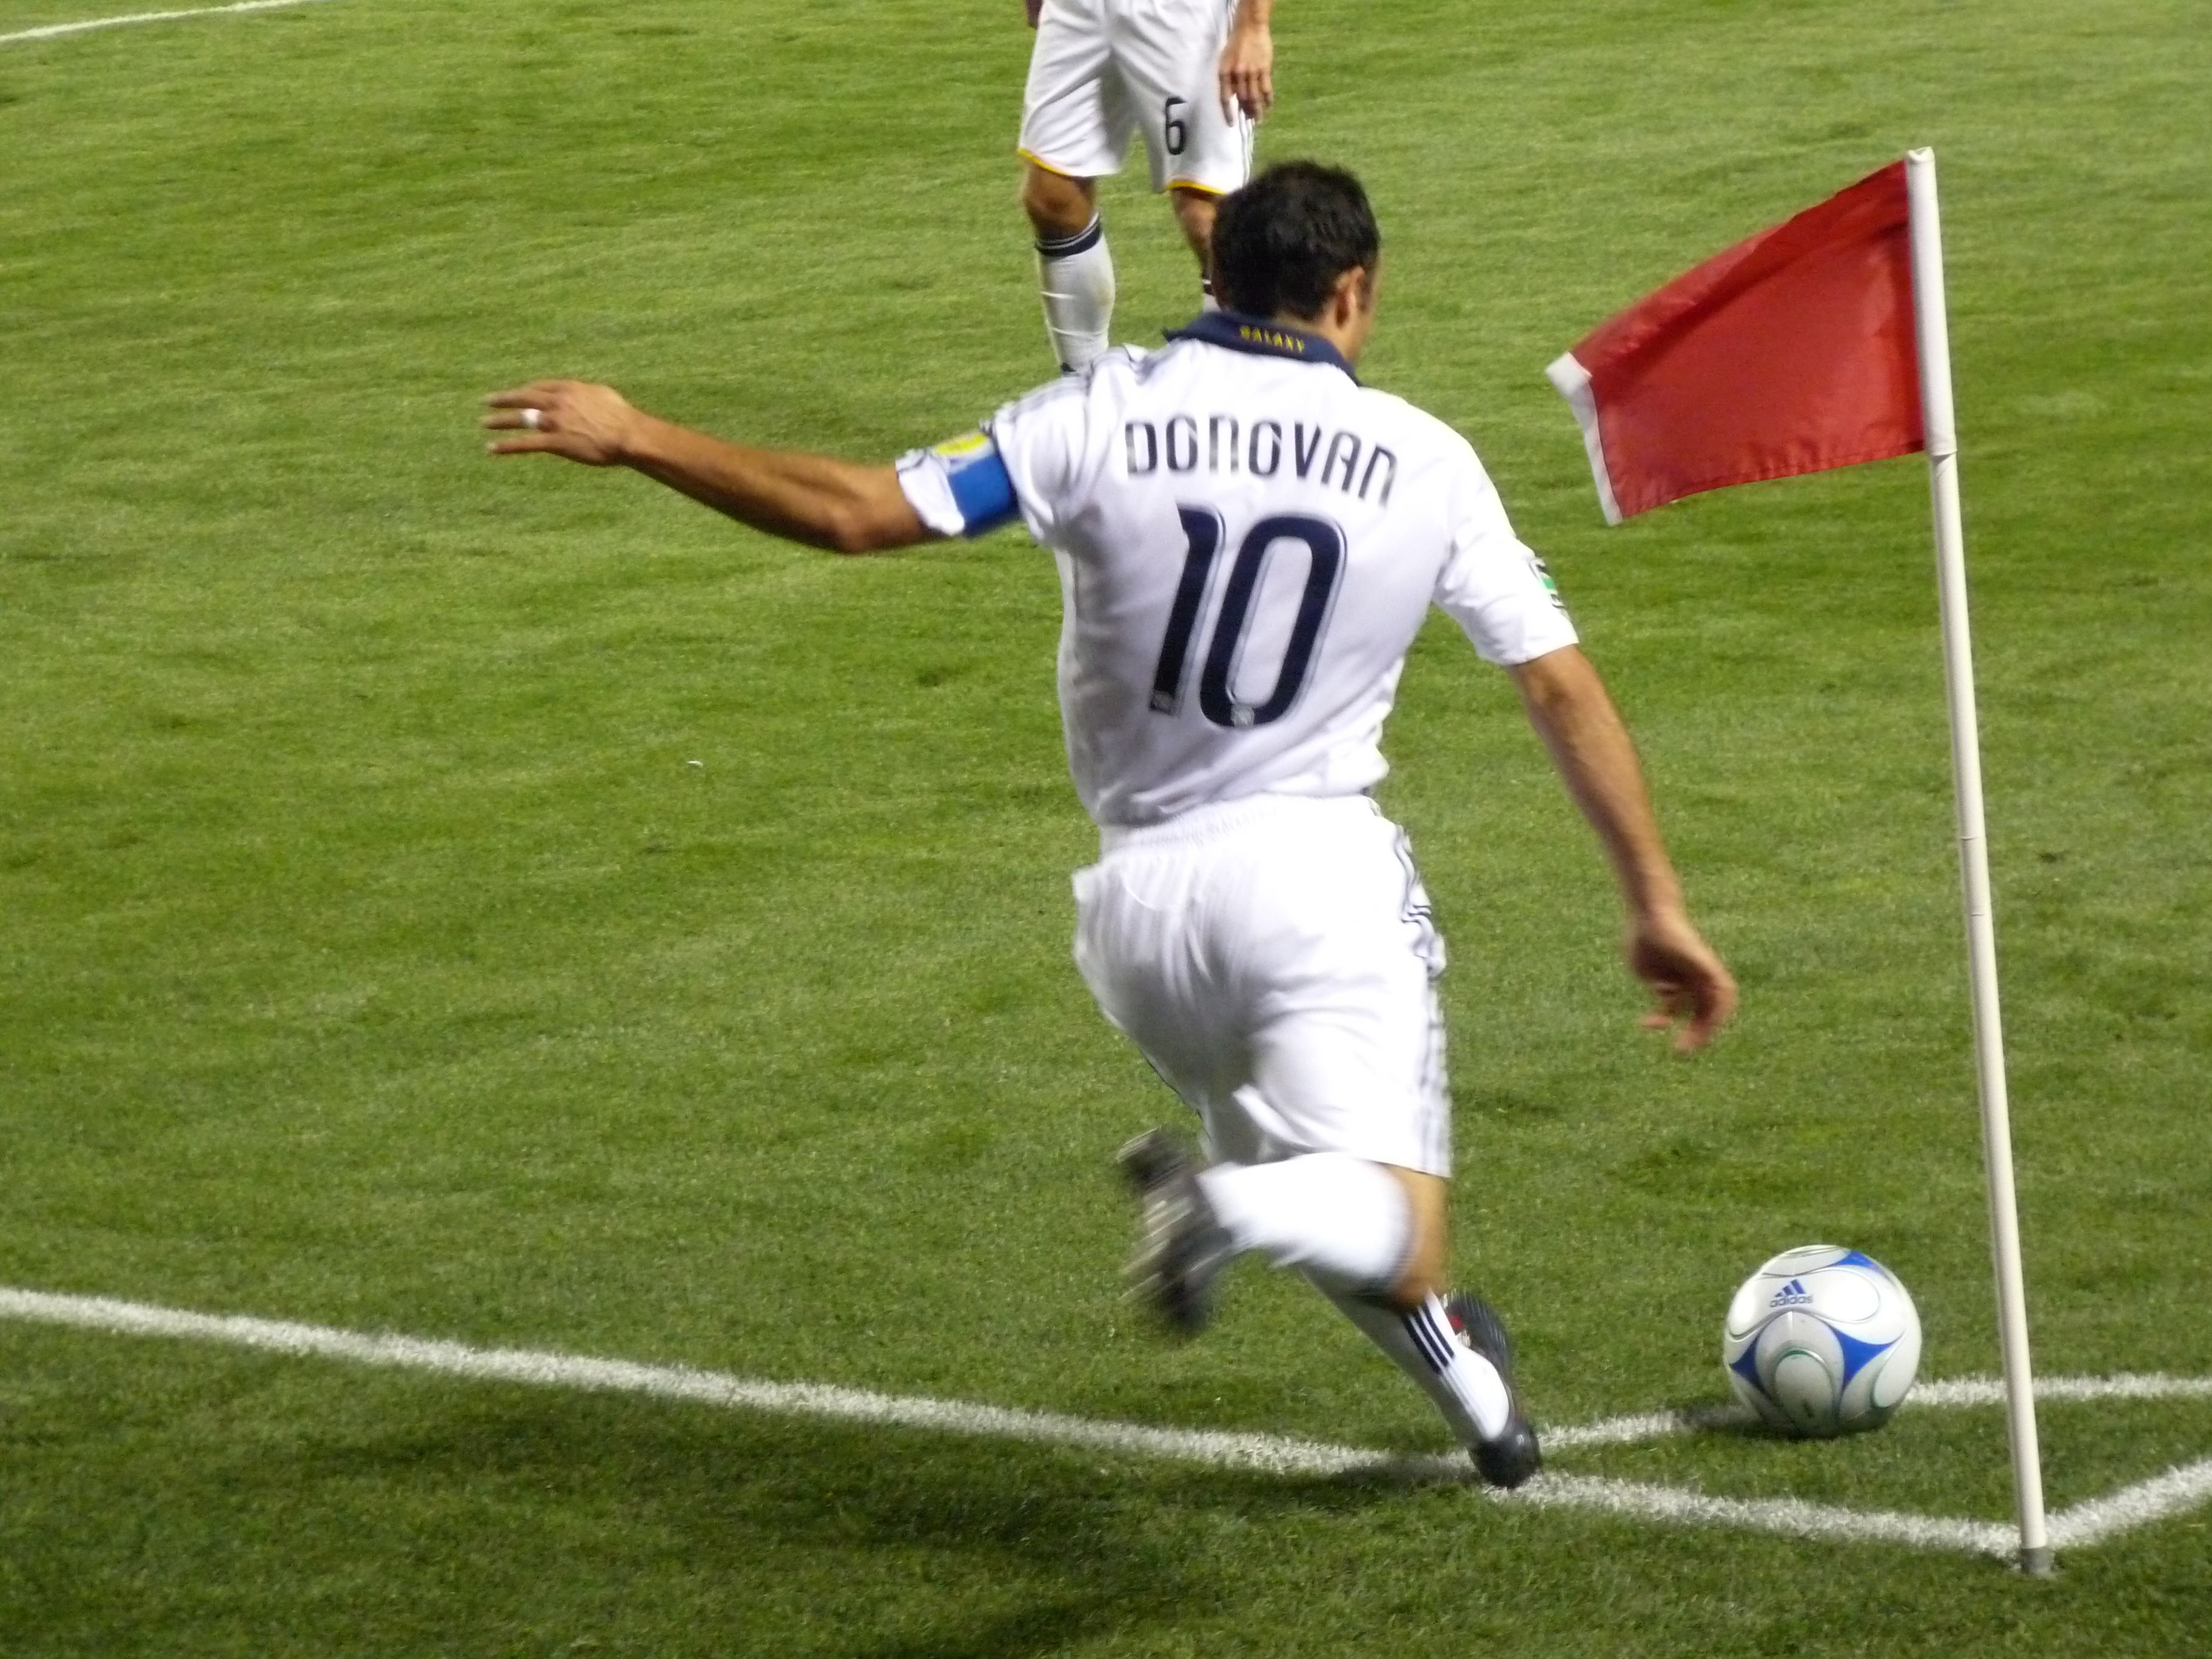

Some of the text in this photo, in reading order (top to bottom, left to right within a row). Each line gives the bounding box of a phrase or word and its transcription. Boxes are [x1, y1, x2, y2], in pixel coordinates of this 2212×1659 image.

[1165, 95, 1187, 155] 6
[1124, 413, 1398, 509] DONOVAN
[1149, 498, 1347, 728] 10
[1770, 1294, 1813, 1307] adidas
